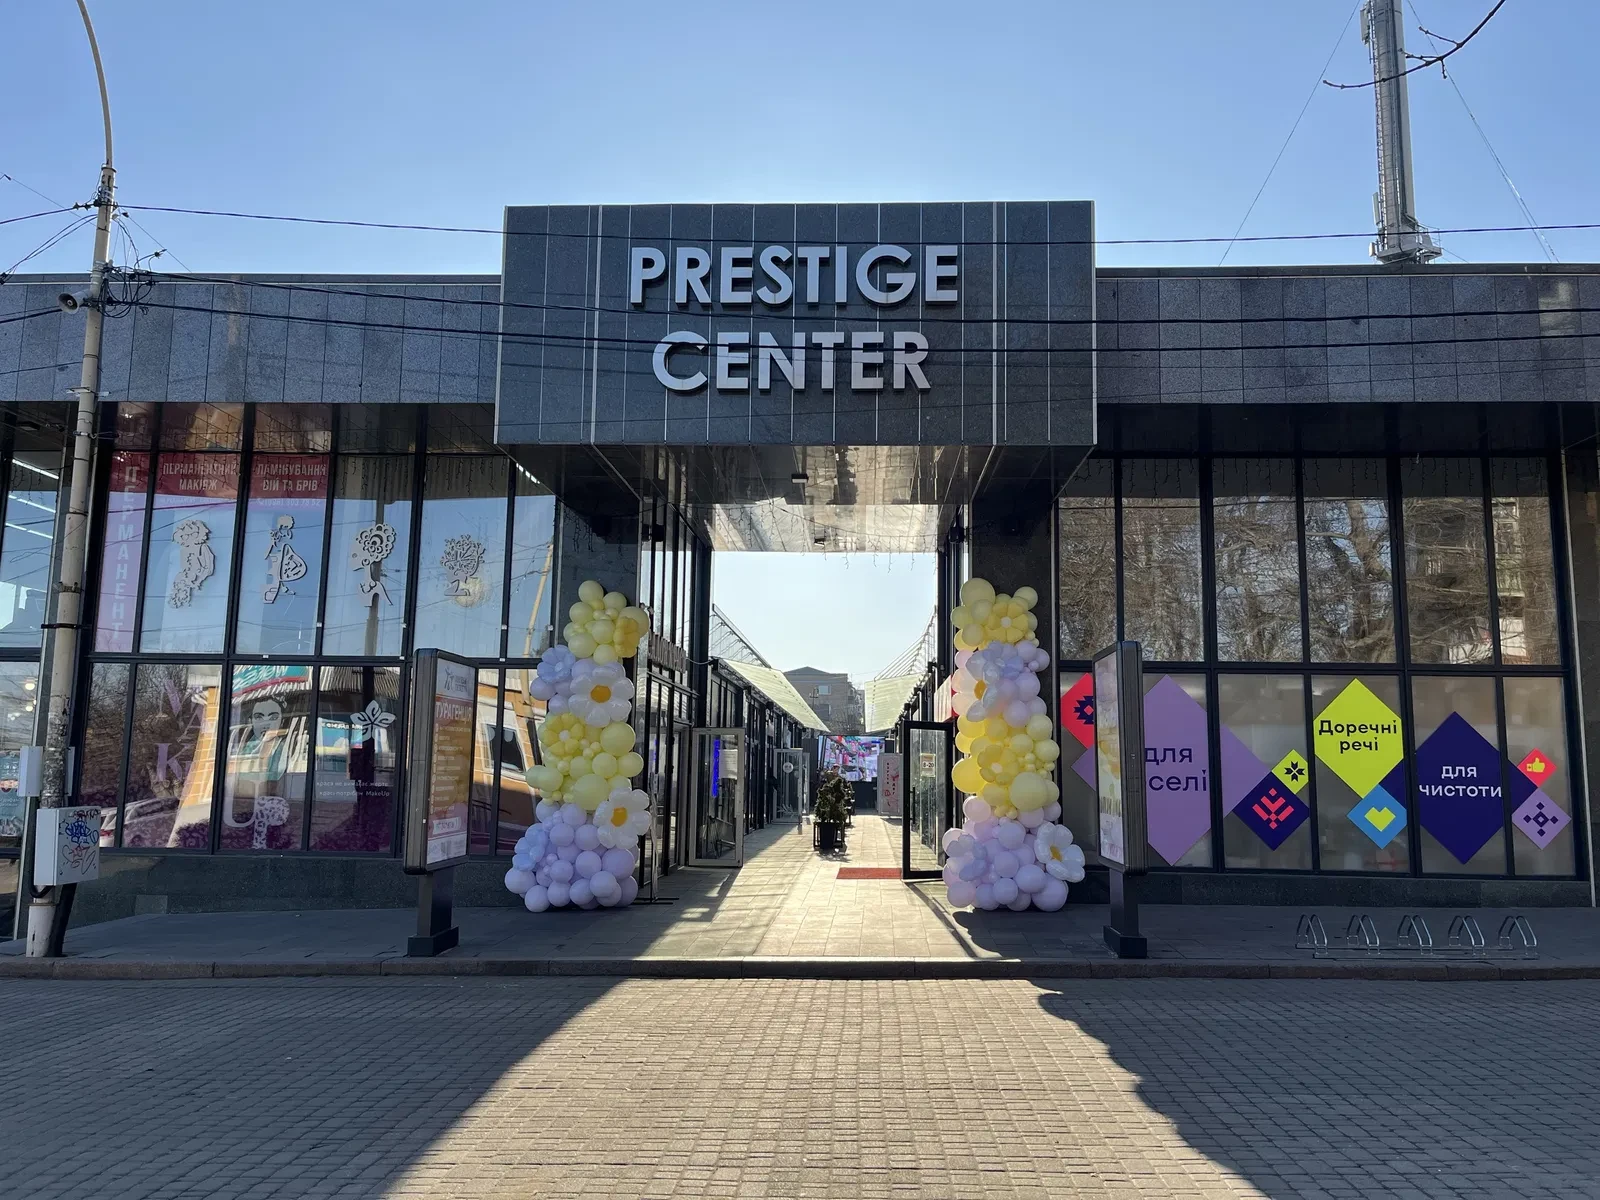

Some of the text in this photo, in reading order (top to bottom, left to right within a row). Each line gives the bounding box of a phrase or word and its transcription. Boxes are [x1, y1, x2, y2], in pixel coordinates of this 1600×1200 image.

[630, 245, 958, 305] PRESTIGE
[652, 330, 931, 391] CENTER
[179, 479, 218, 491] МАКІЯЖ
[281, 480, 293, 491] ТА
[296, 480, 318, 491] БРІВ
[111, 466, 140, 640] ПЕРМАНЕНТ
[1318, 719, 1398, 736] Доречні
[1339, 736, 1379, 753] речі
[1145, 747, 1193, 765] для
[1441, 765, 1477, 778] для
[1148, 769, 1208, 792] селі
[1419, 784, 1502, 798] чистоти
